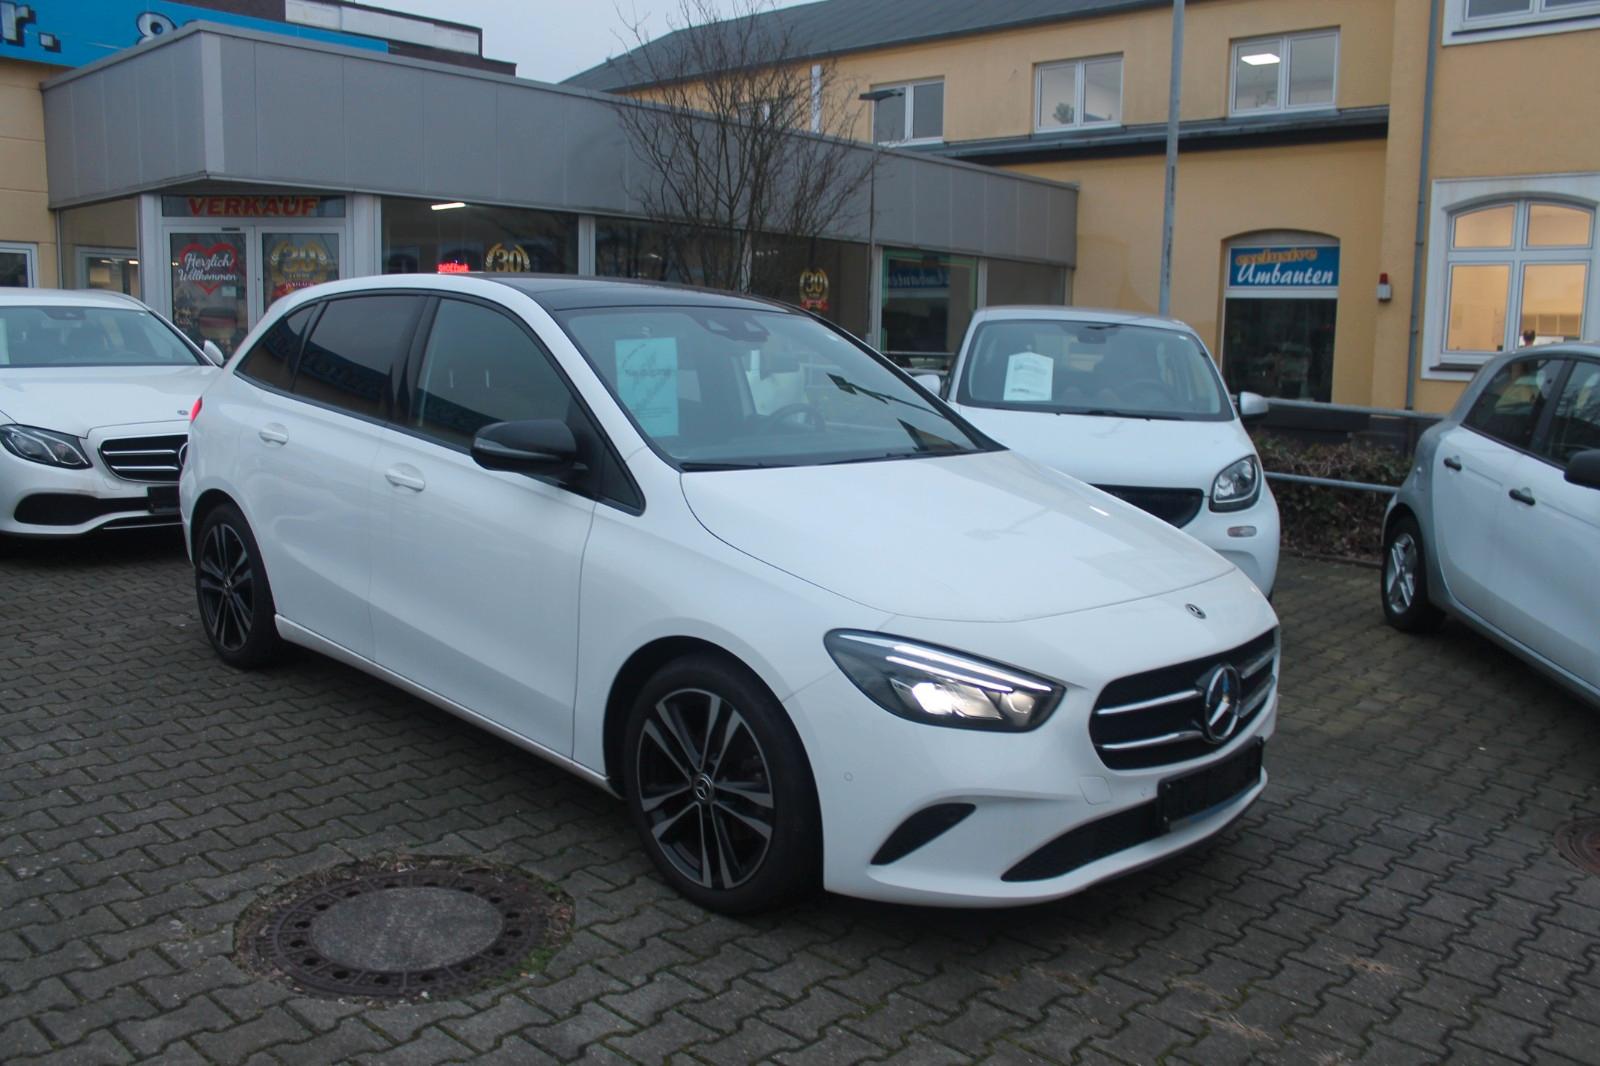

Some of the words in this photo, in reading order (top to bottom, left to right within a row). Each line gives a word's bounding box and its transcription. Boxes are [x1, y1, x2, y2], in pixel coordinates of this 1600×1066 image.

[188, 197, 318, 217] VERKAUF
[184, 252, 234, 272] Herzlich
[495, 249, 522, 273] 30
[178, 268, 237, 282] Willkommen
[805, 271, 824, 292] 30
[1237, 262, 1333, 284] Umbauten
